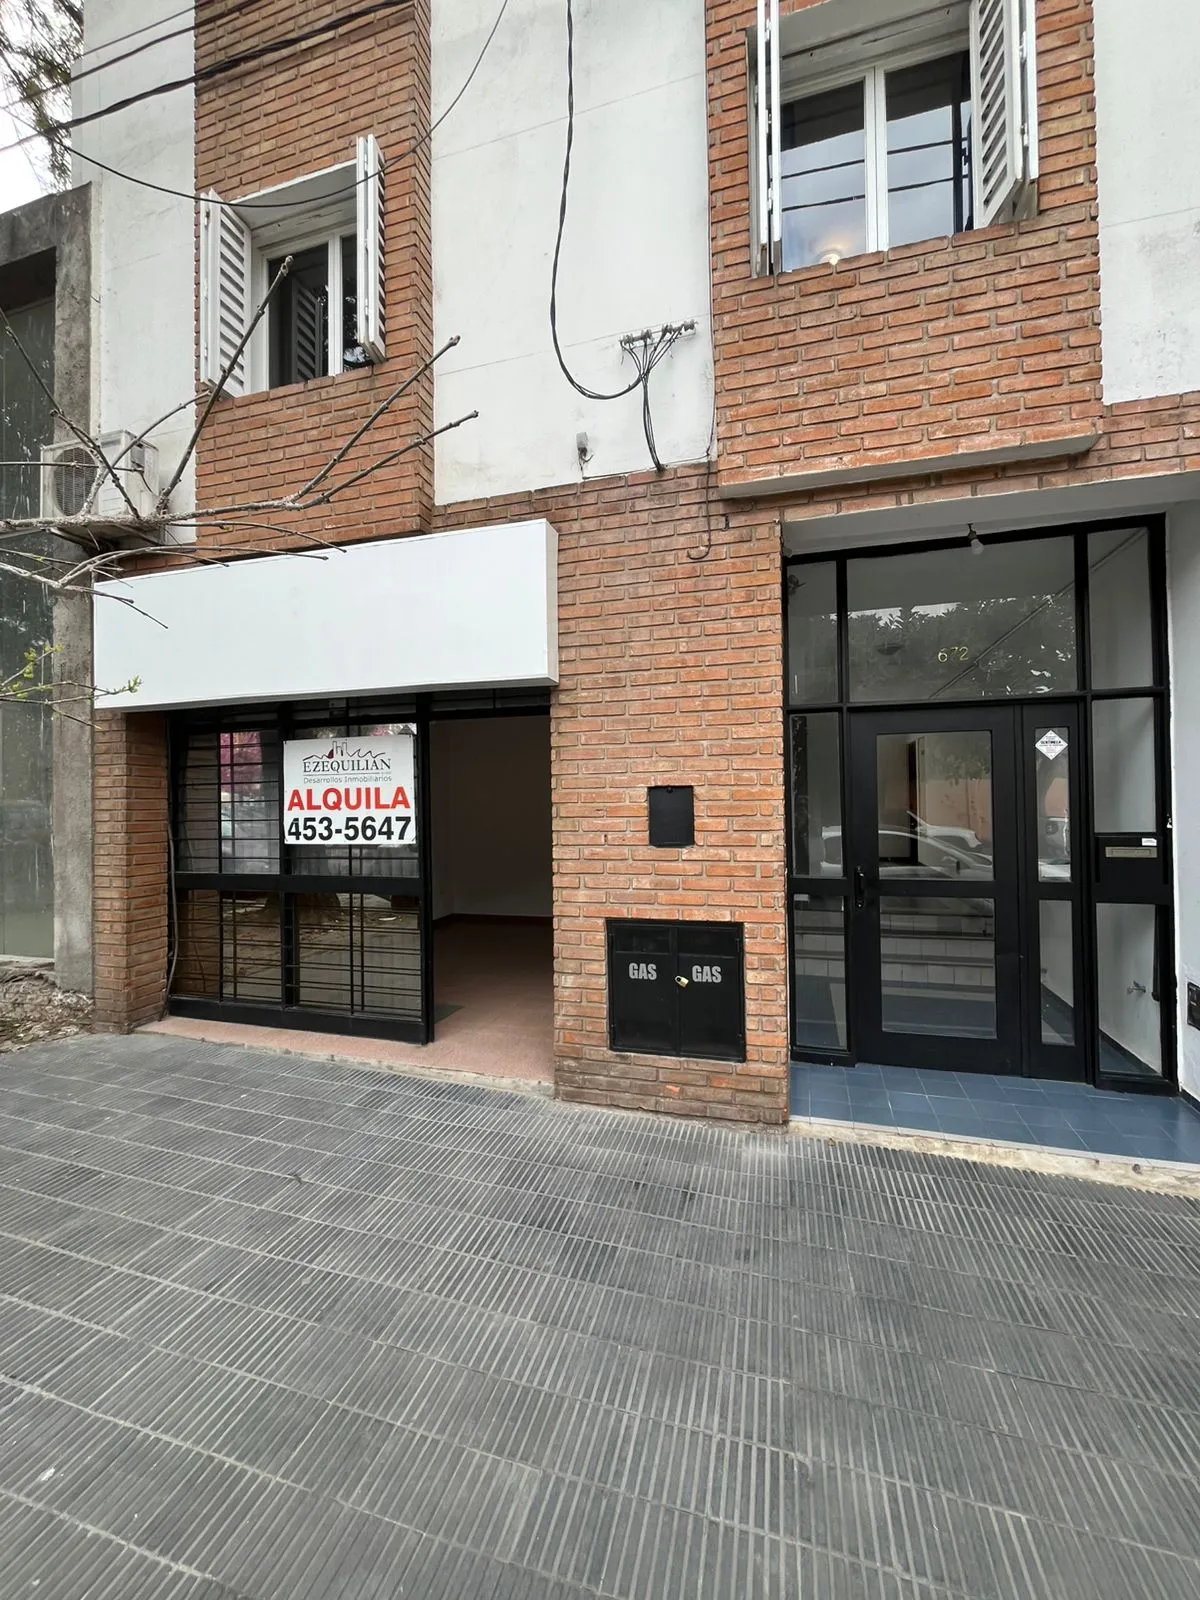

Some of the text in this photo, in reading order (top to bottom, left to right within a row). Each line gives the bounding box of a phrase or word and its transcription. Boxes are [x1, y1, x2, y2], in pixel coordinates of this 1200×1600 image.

[938, 646, 969, 662] 672
[303, 759, 391, 772] EZEQUILIAN
[303, 775, 392, 784] Desarrollos Inmobiliarios
[287, 786, 411, 811] ALQUILA
[287, 816, 411, 840] 453-5647
[628, 962, 657, 980] GAS
[692, 965, 721, 983] GAS
